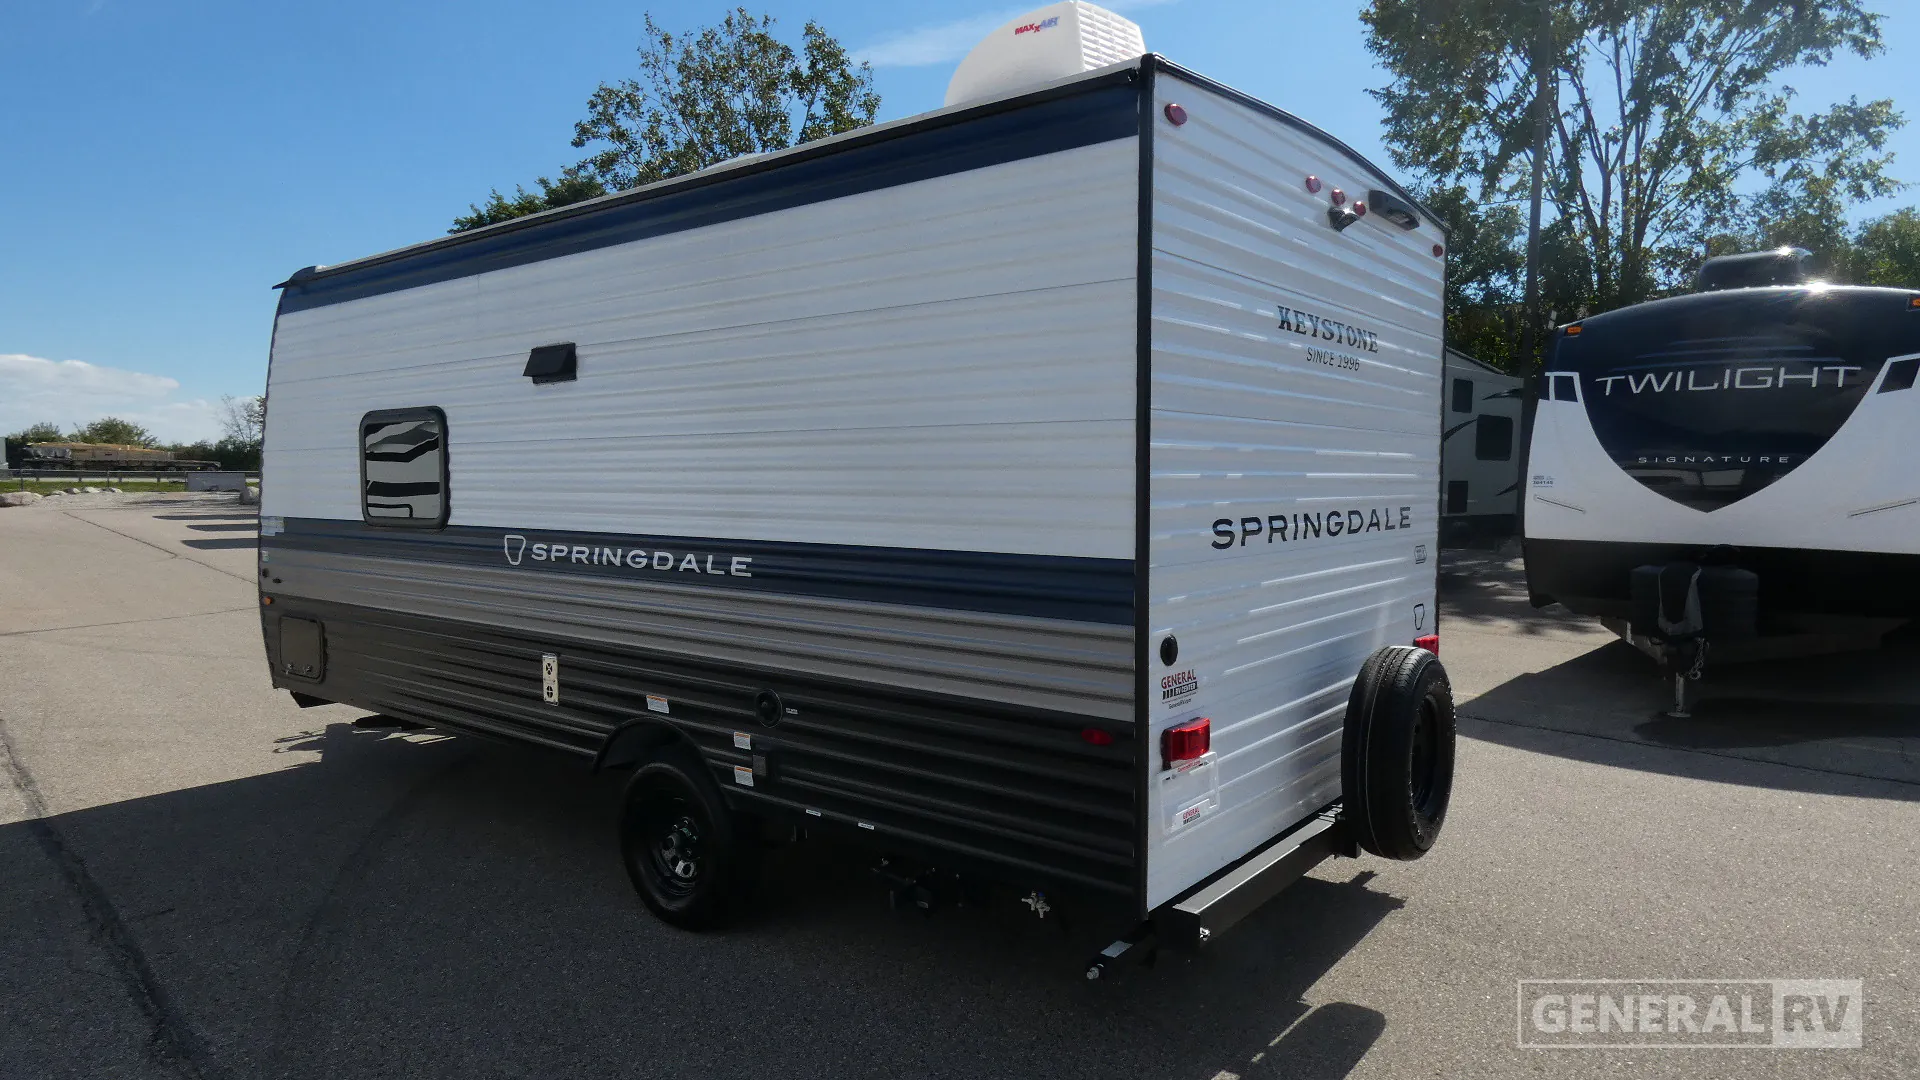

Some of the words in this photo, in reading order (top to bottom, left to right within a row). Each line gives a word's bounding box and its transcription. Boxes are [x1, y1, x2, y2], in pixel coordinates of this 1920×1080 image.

[1277, 305, 1378, 354] KEYSTONE
[1306, 346, 1334, 367] SINCE
[1337, 354, 1360, 372] 1996
[1596, 366, 1861, 396] TWILIGHT
[1638, 456, 1789, 464] SIGNATURE
[1211, 506, 1411, 550] SPRINGDALE
[531, 543, 753, 578] SPRINGDALE
[1161, 669, 1197, 689] GENERAL
